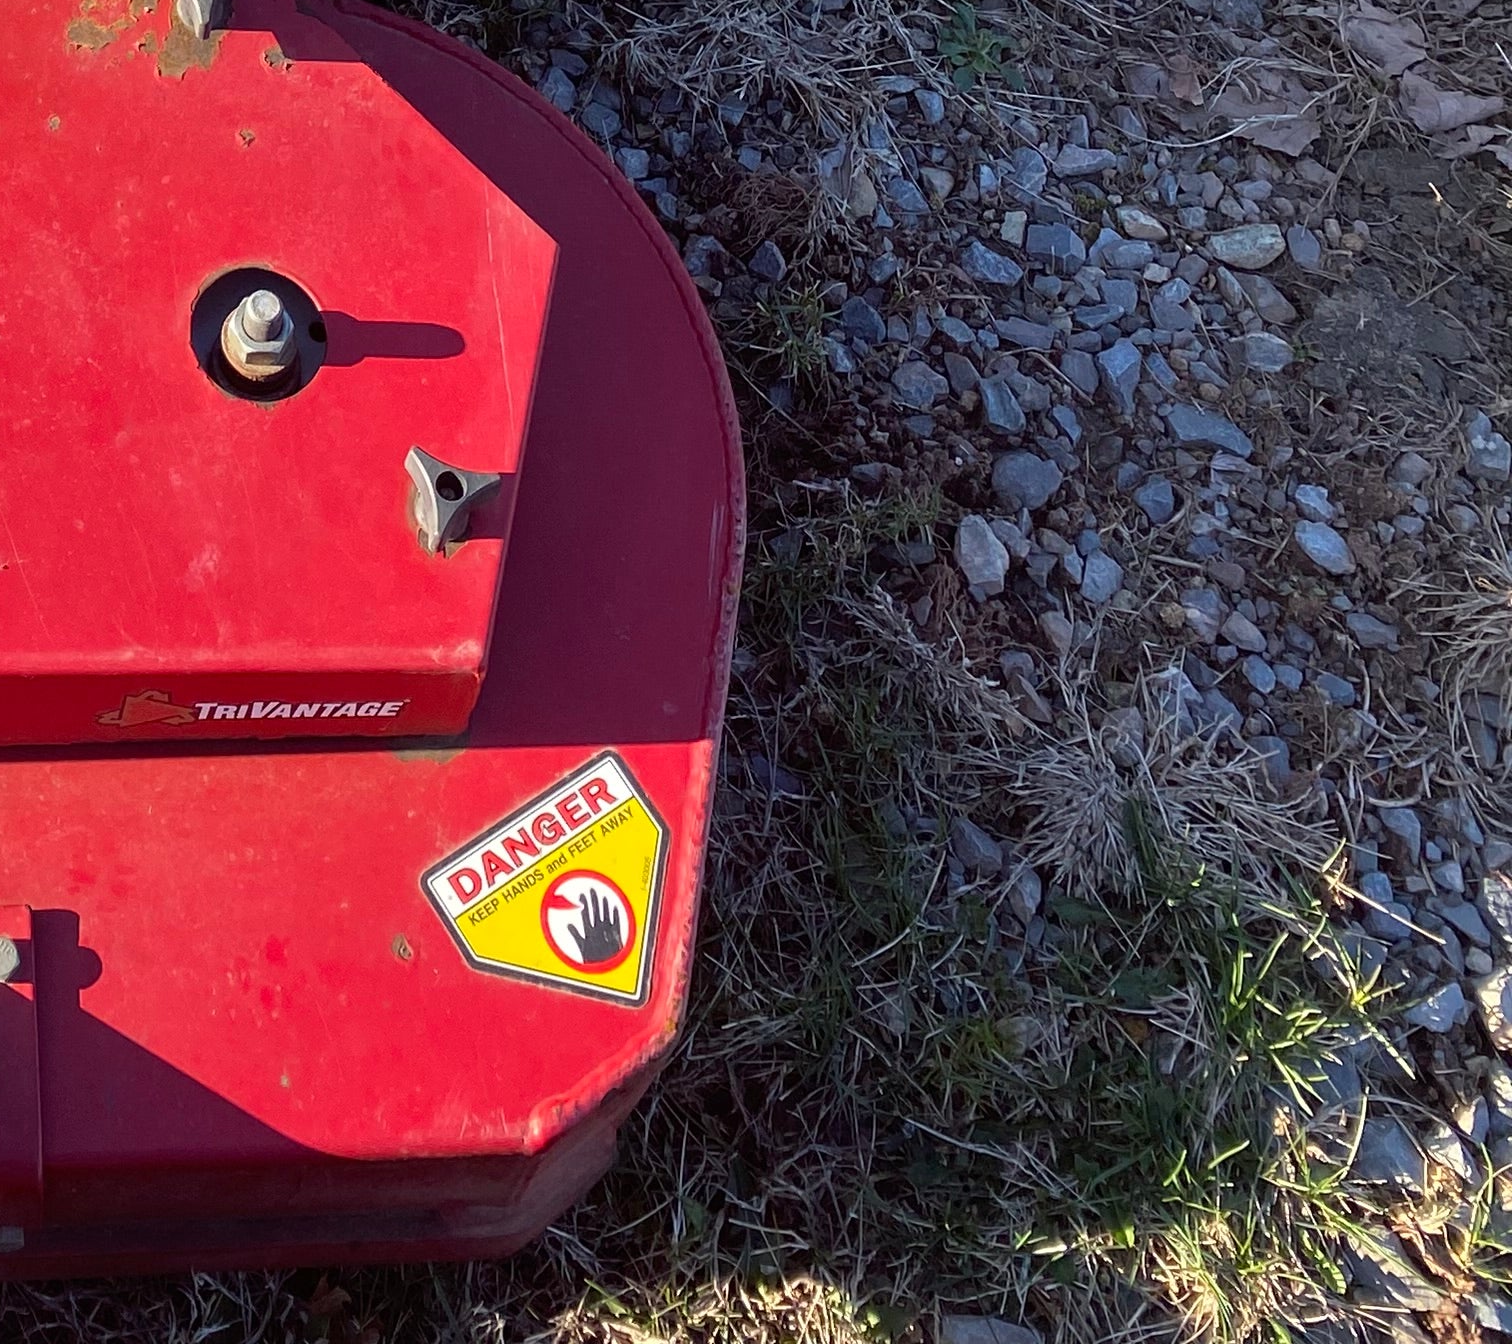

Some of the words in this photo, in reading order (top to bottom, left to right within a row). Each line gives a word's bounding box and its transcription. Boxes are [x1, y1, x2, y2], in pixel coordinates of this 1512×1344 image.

[446, 776, 618, 905] DANGER
[467, 898, 500, 926] KEEP
[501, 868, 544, 904] HANDS
[546, 853, 568, 875] and
[568, 830, 598, 859] FEET
[600, 806, 635, 837] AWAY
